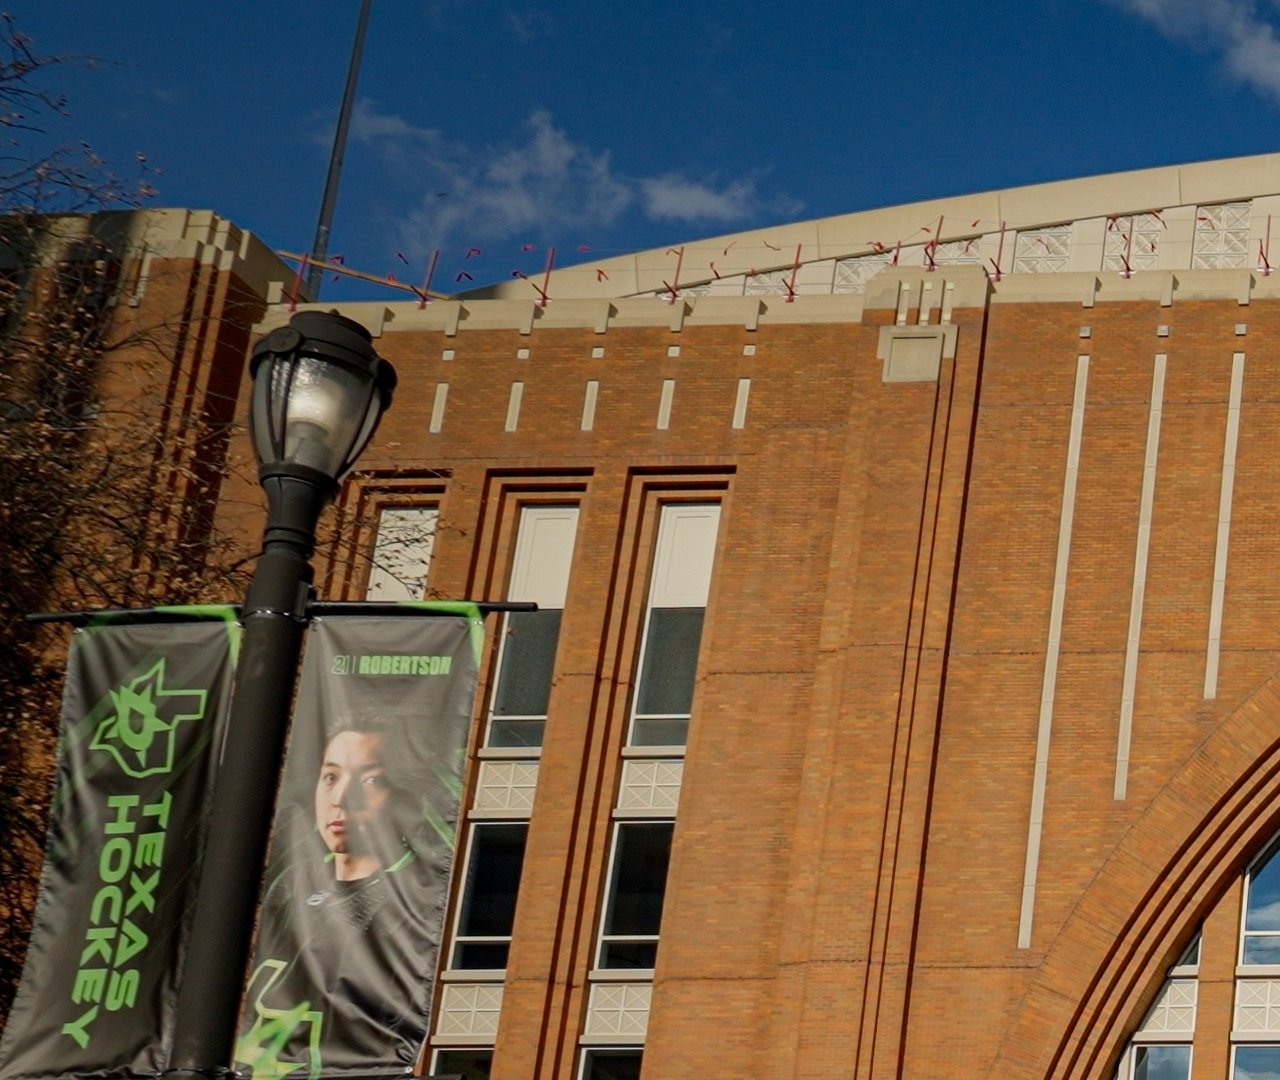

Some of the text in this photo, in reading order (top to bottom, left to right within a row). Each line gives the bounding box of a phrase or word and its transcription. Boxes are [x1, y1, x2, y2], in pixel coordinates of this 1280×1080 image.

[359, 655, 452, 675] ROBERTSON
[61, 795, 140, 1049] HOCKEY
[104, 790, 172, 1011] TEXAS
